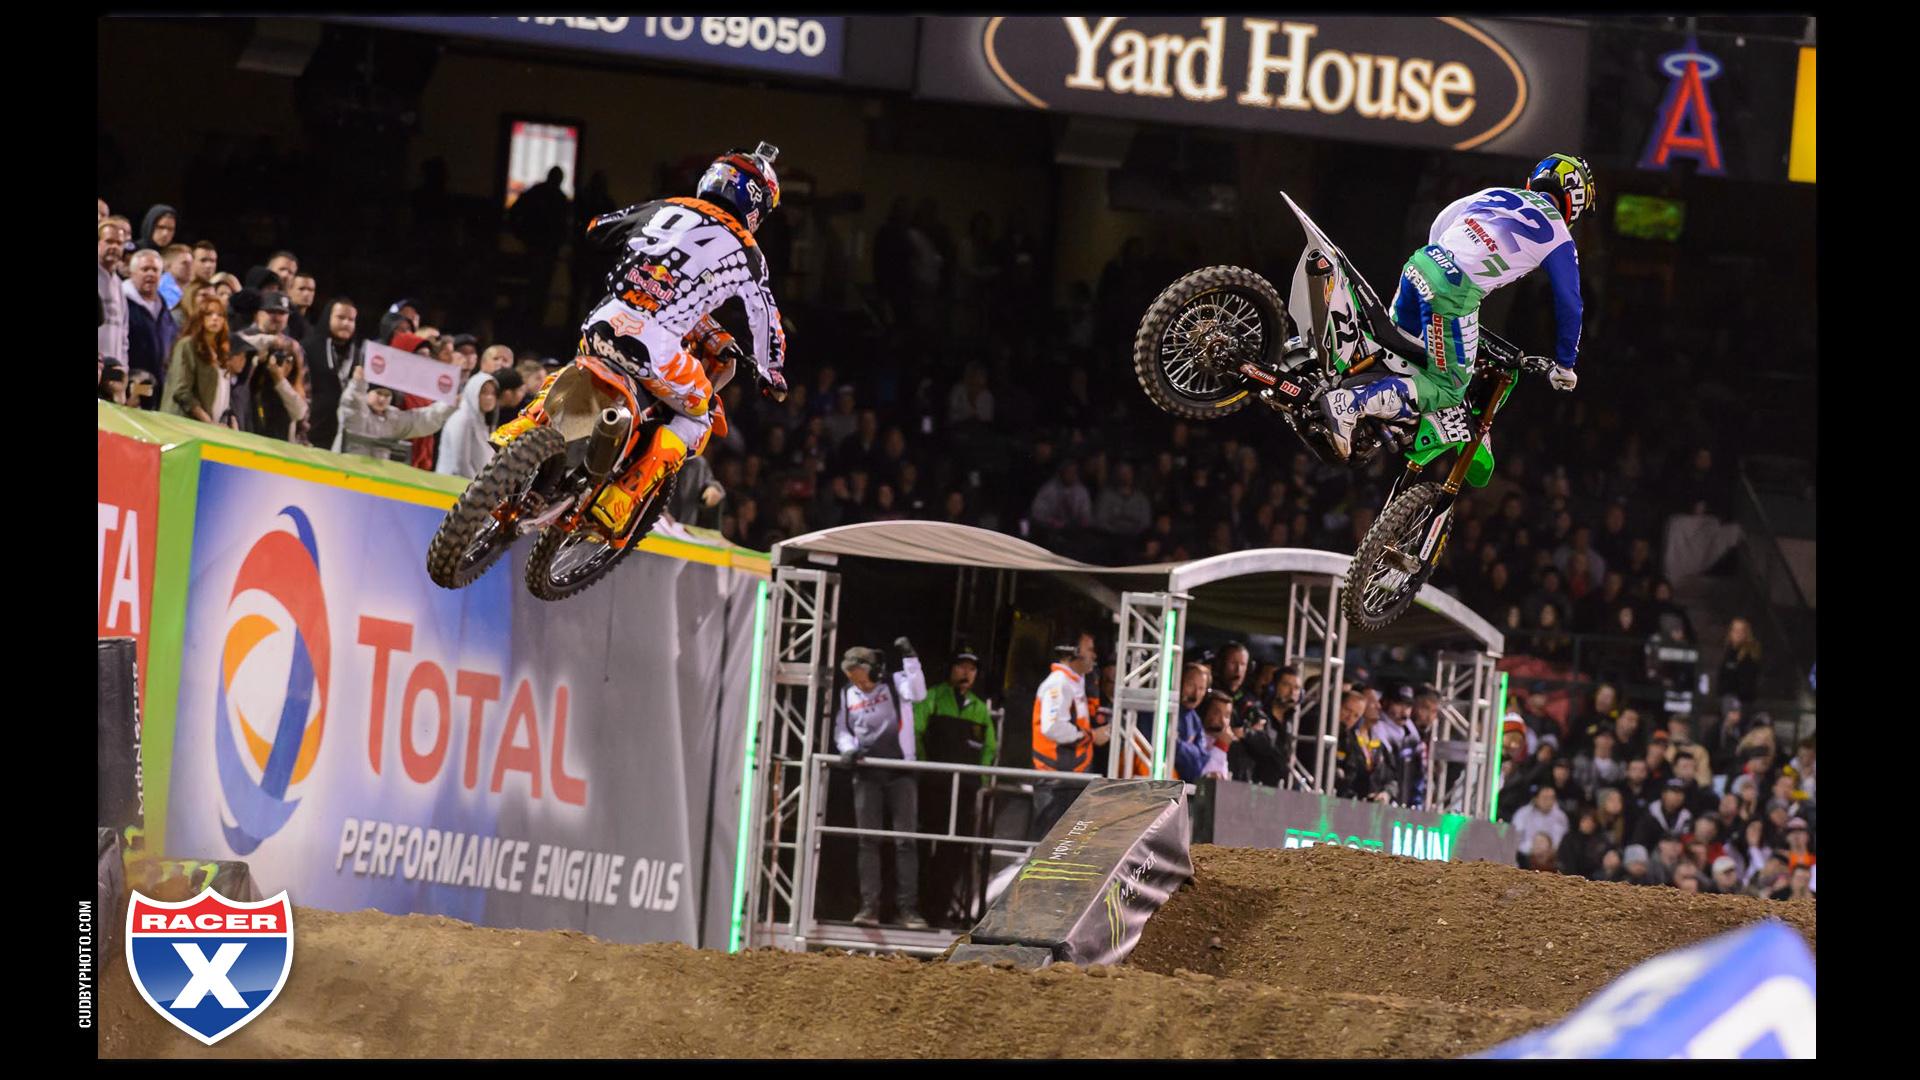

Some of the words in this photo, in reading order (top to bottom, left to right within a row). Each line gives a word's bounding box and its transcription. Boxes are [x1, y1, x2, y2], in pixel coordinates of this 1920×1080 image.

[700, 17, 827, 57] 69050
[1064, 17, 1227, 102] Yard
[1238, 20, 1478, 126] House
[628, 206, 743, 281] 94
[1465, 190, 1555, 254] 22
[1404, 265, 1434, 301] SPEEDY
[1427, 249, 1459, 275] SHIFT
[1280, 381, 1301, 397] DID
[357, 615, 588, 807] TOTAL
[336, 818, 530, 893] PERFORMANCE
[530, 844, 625, 906] ENGINE
[629, 857, 685, 912] OILS
